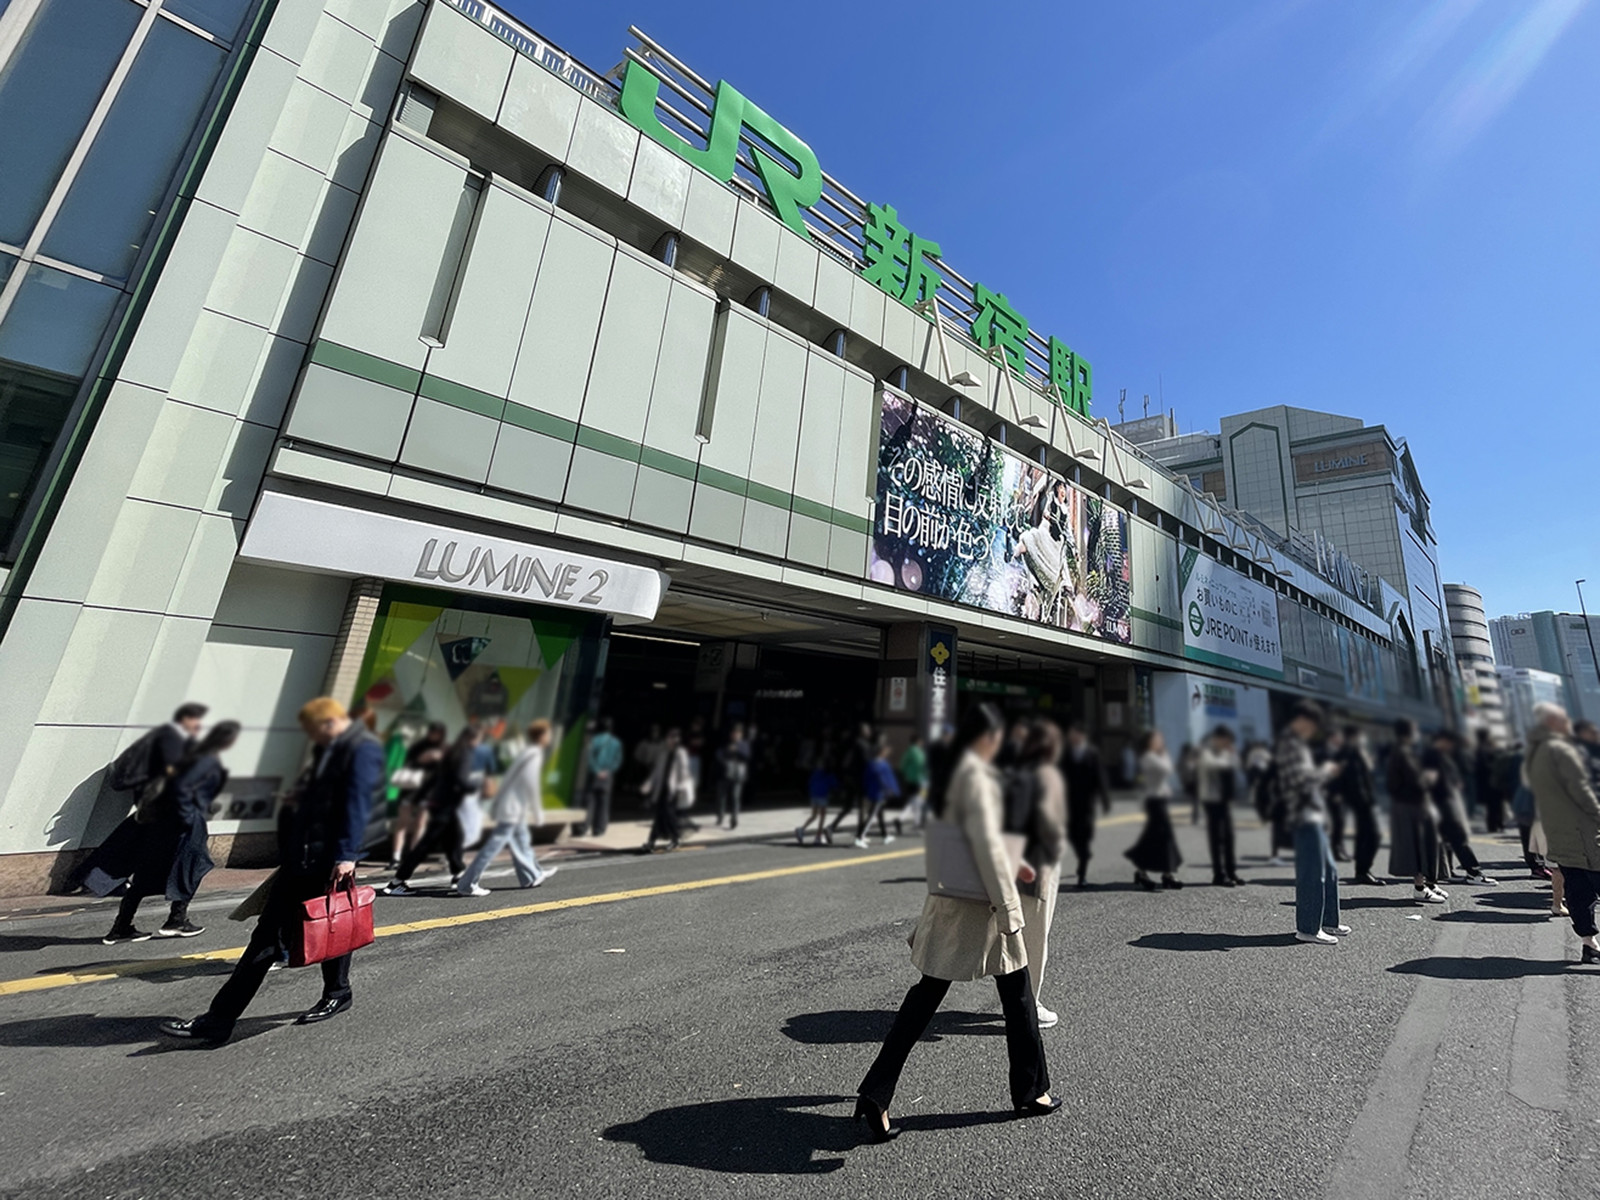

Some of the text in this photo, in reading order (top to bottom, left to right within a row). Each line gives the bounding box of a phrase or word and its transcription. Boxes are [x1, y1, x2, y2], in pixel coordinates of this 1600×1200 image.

[619, 59, 1093, 419] JR 新宿駅
[1314, 454, 1369, 473] LUMINE
[414, 538, 610, 606] LUMINE 2
[1196, 586, 1238, 616] お買いものに
[1205, 617, 1223, 639] JRE
